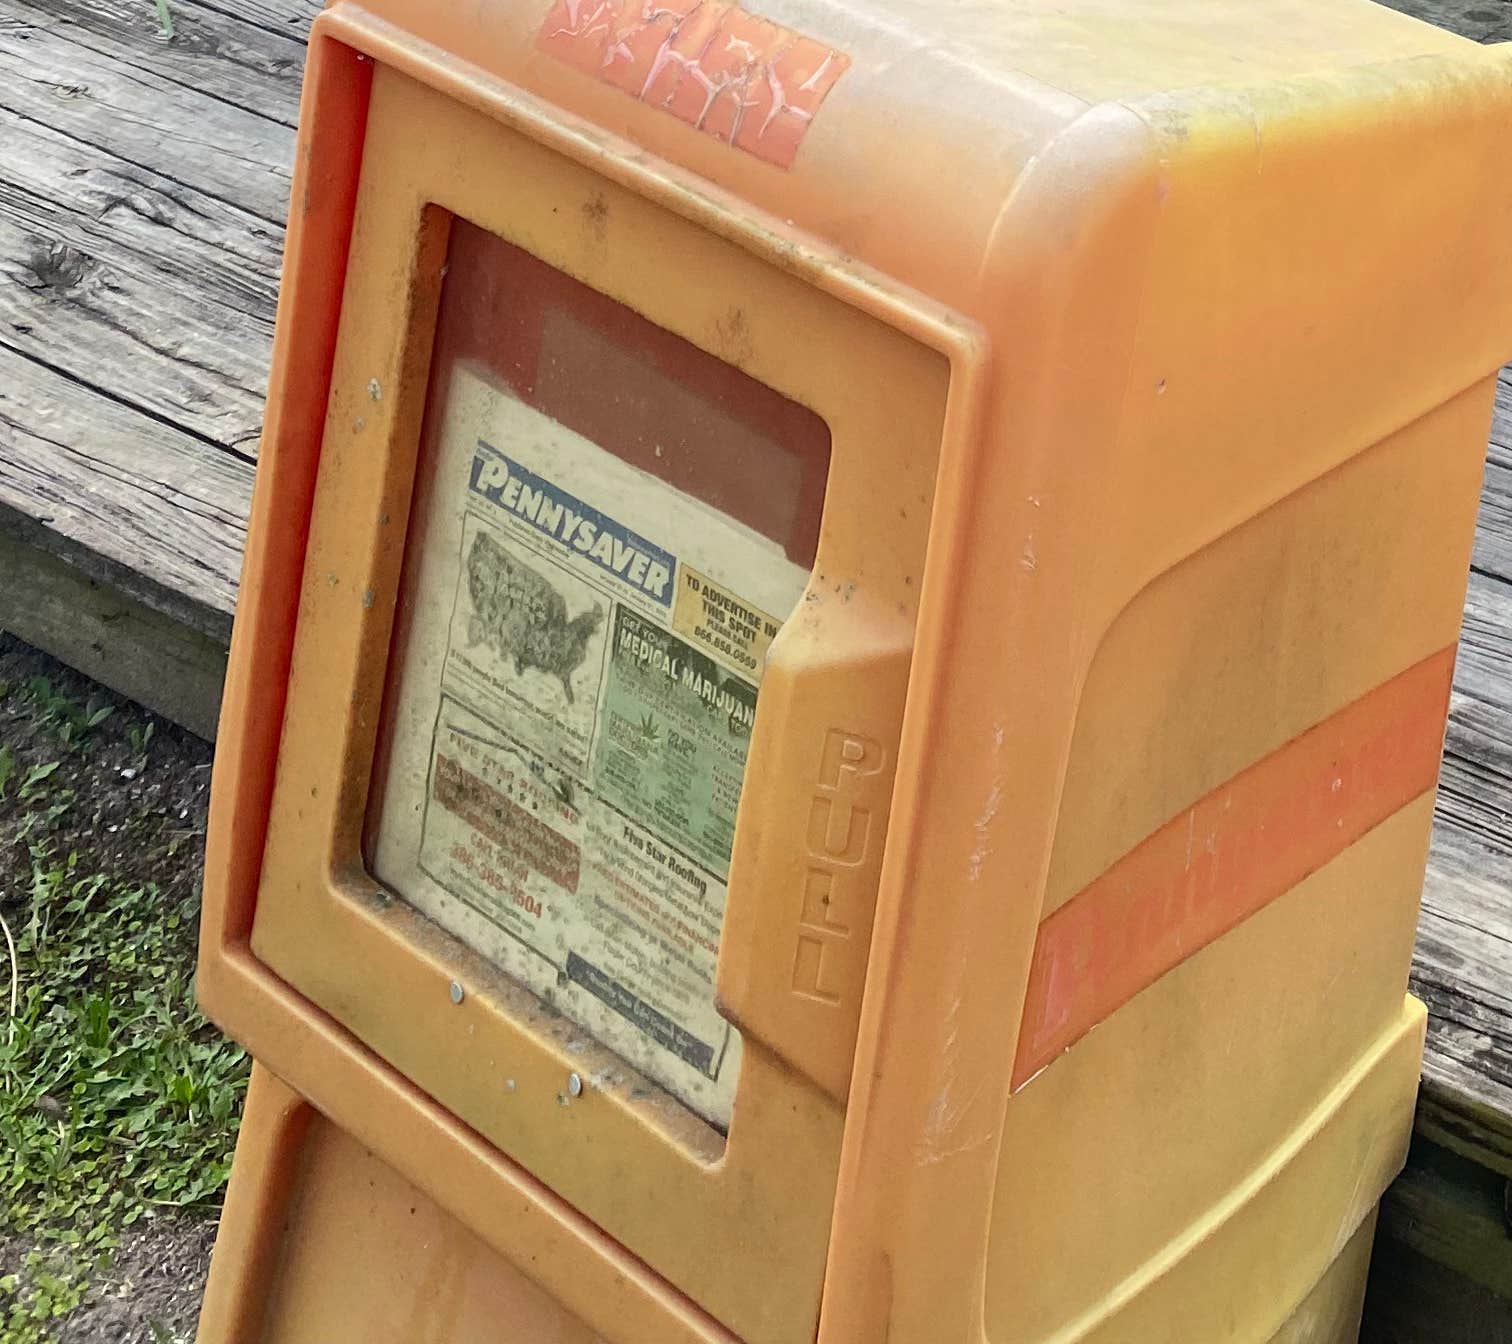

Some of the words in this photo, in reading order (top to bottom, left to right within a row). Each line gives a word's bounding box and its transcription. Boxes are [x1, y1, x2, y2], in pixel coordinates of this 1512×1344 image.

[476, 456, 671, 598] PENNYSAVER
[686, 573, 700, 591] TO
[702, 585, 761, 630] ADVERTISE
[702, 598, 725, 624] THIS
[728, 616, 757, 643] SPOT
[619, 628, 679, 681] MEDICAL
[645, 841, 667, 865] Star
[668, 855, 708, 899] Roofing
[792, 728, 886, 1006] PULL
